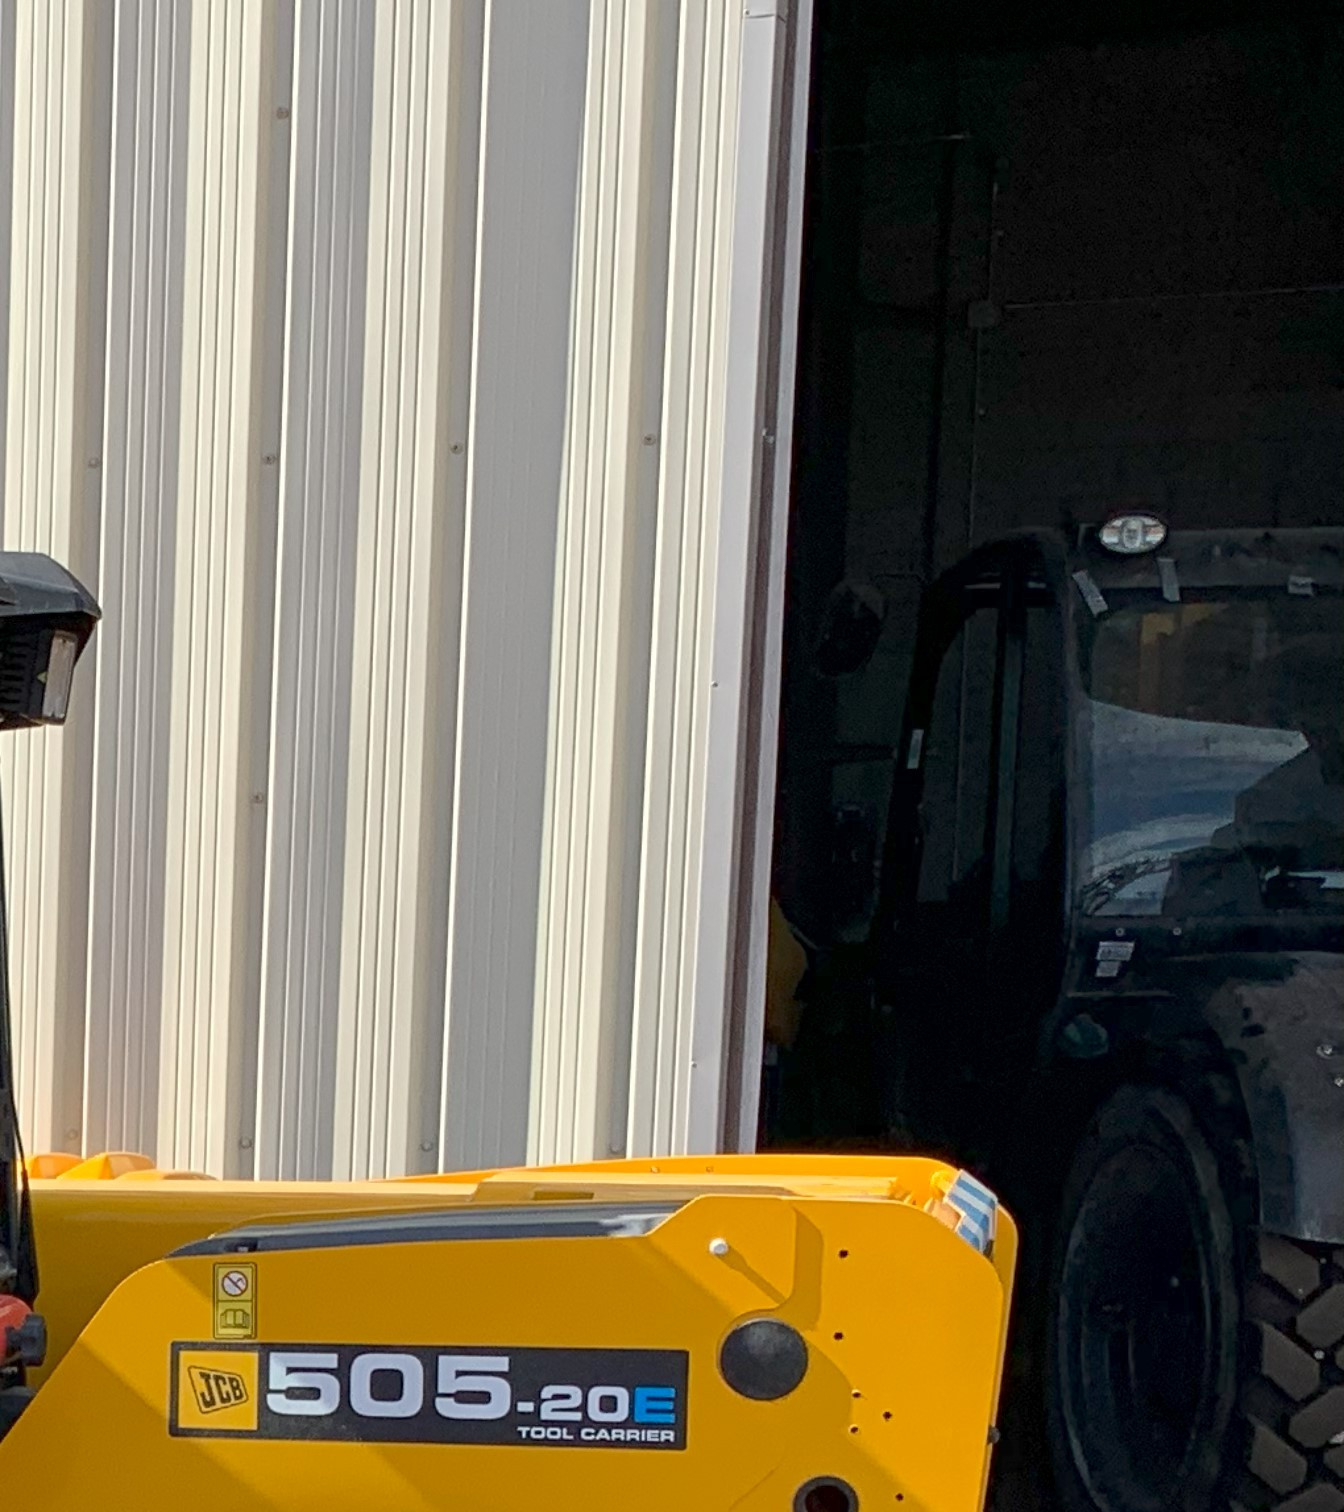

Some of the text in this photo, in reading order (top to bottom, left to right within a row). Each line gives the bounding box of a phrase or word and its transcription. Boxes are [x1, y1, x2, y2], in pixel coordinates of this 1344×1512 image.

[198, 1371, 244, 1409] JCB
[517, 1426, 675, 1443] TOOL CARRIER
